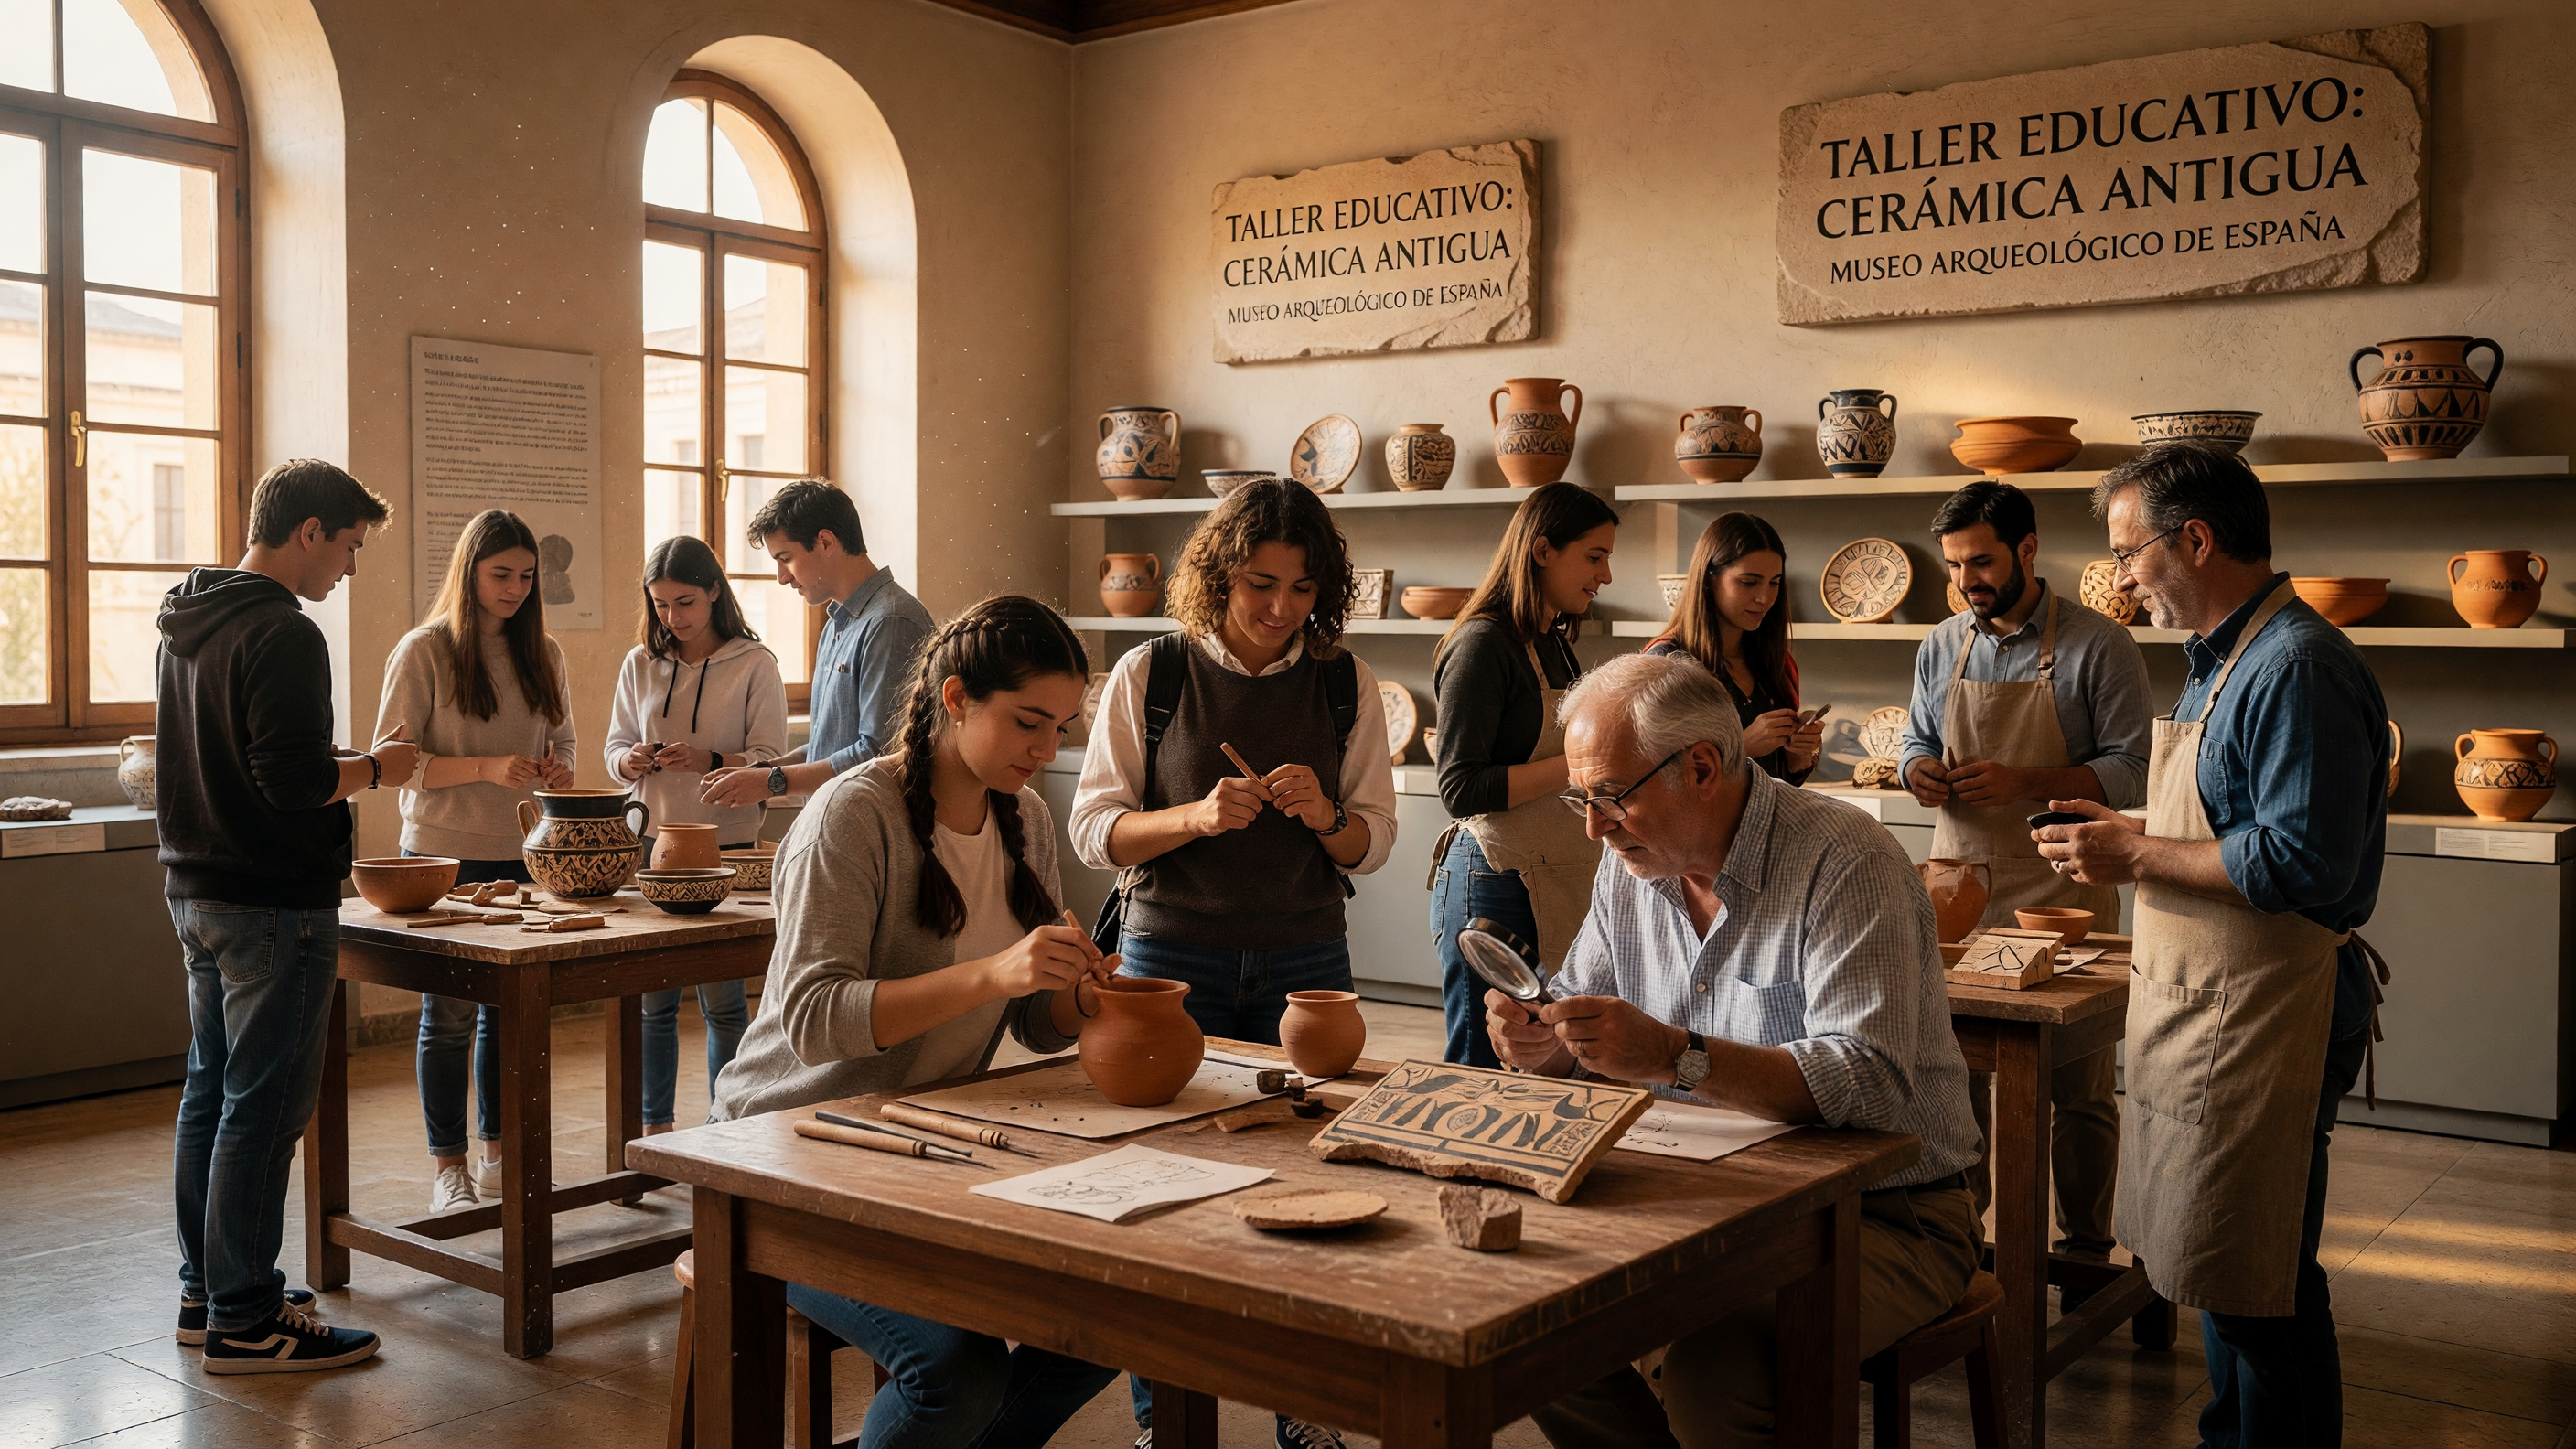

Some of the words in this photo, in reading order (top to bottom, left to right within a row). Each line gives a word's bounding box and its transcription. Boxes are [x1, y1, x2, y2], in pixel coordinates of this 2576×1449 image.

[1819, 121, 2002, 180] TALLER
[2018, 76, 2364, 157] EDUCATIVO:
[1224, 203, 1326, 243] TALLER
[1334, 180, 1514, 231] EDUCATIVO:
[1816, 175, 2085, 240] CERÁMICA
[2098, 142, 2370, 212] ANTIGUA
[1223, 244, 1367, 288] CERÁMICA
[1374, 227, 1512, 273] ANTIGUA
[1830, 253, 1923, 284] MUSEO
[1929, 231, 2164, 276] ARQUEOLÓGICO
[2174, 225, 2215, 254] DE
[2224, 209, 2346, 250] ESPAÑA
[1228, 303, 1280, 325] MUSEO
[1283, 289, 1408, 323] ARQUEOLÓGICO
[1412, 286, 1434, 307] DE
[1440, 277, 1503, 305] ESPAÑA
